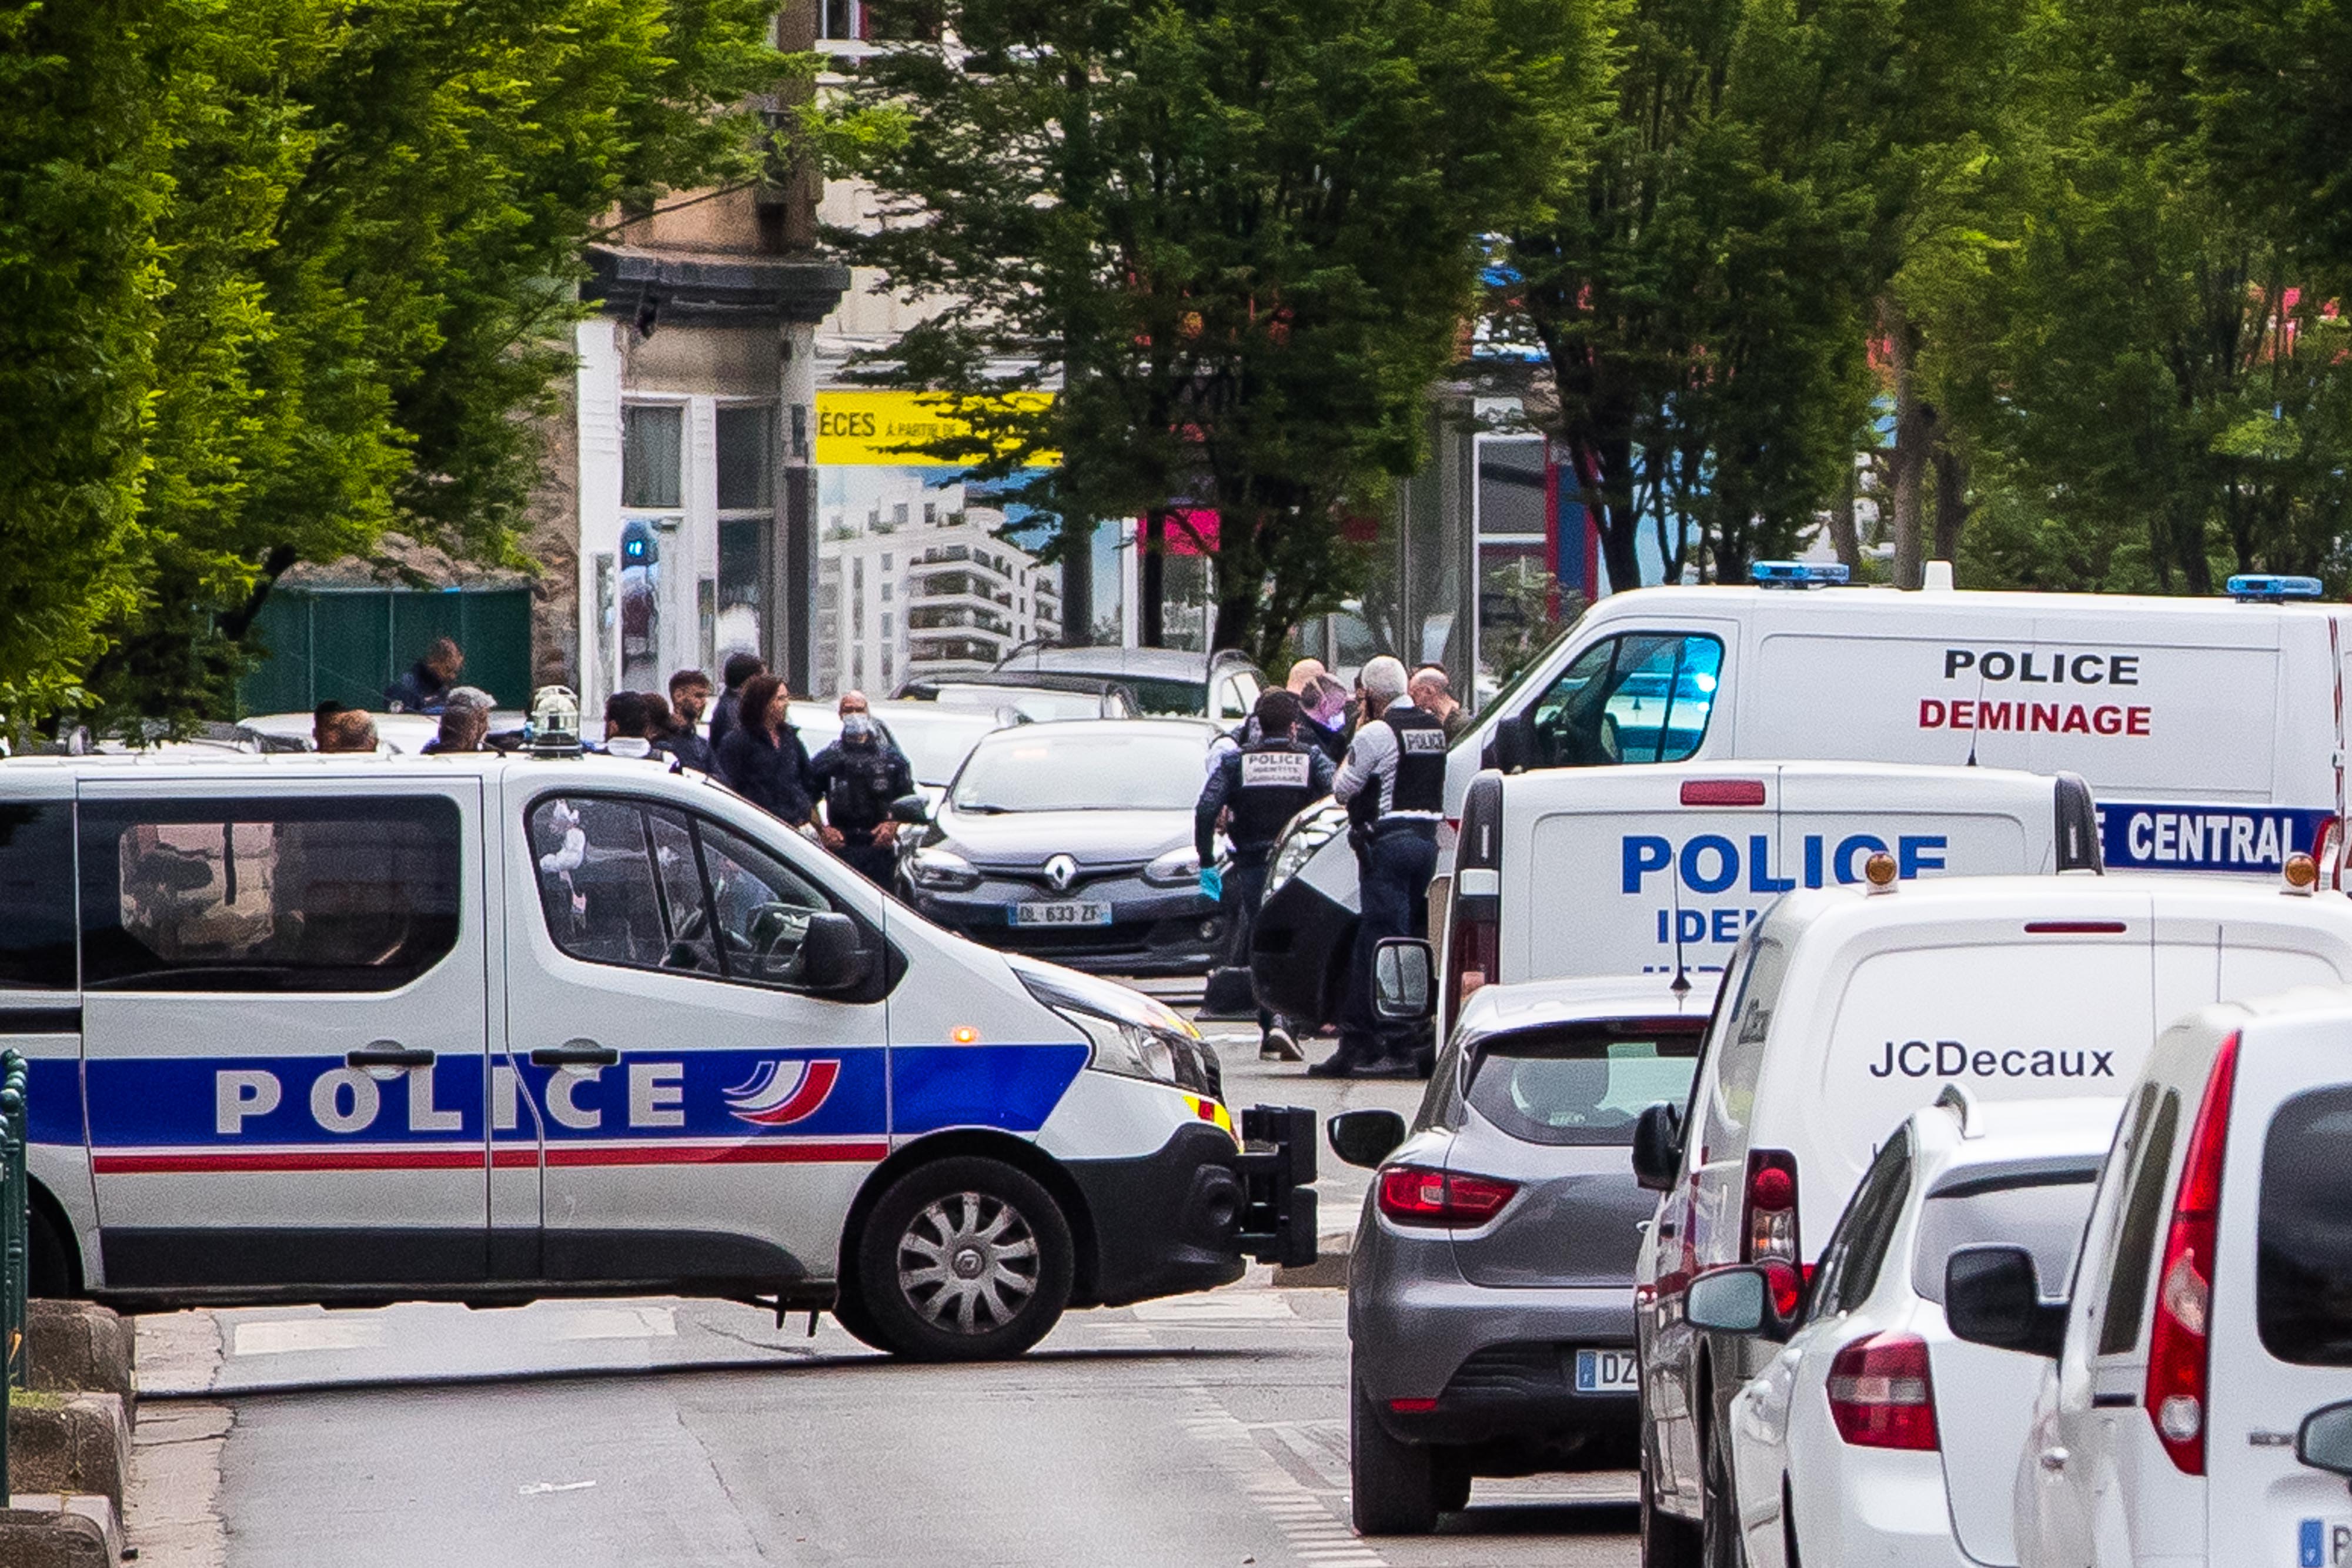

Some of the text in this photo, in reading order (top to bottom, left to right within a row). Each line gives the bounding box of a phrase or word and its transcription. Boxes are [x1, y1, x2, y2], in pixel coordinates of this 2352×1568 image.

[1945, 649, 2139, 686] POLICE
[1919, 699, 2152, 736] DEMINAGE
[1249, 754, 1303, 765] POLICE
[1407, 733, 1446, 750] POLICE
[2129, 812, 2293, 864] CENTRAL
[1622, 834, 1947, 894] POLICE
[1870, 1041, 2114, 1077] JCDecaux
[216, 1062, 684, 1134] POLICE
[1603, 1353, 1637, 1383] DZ
